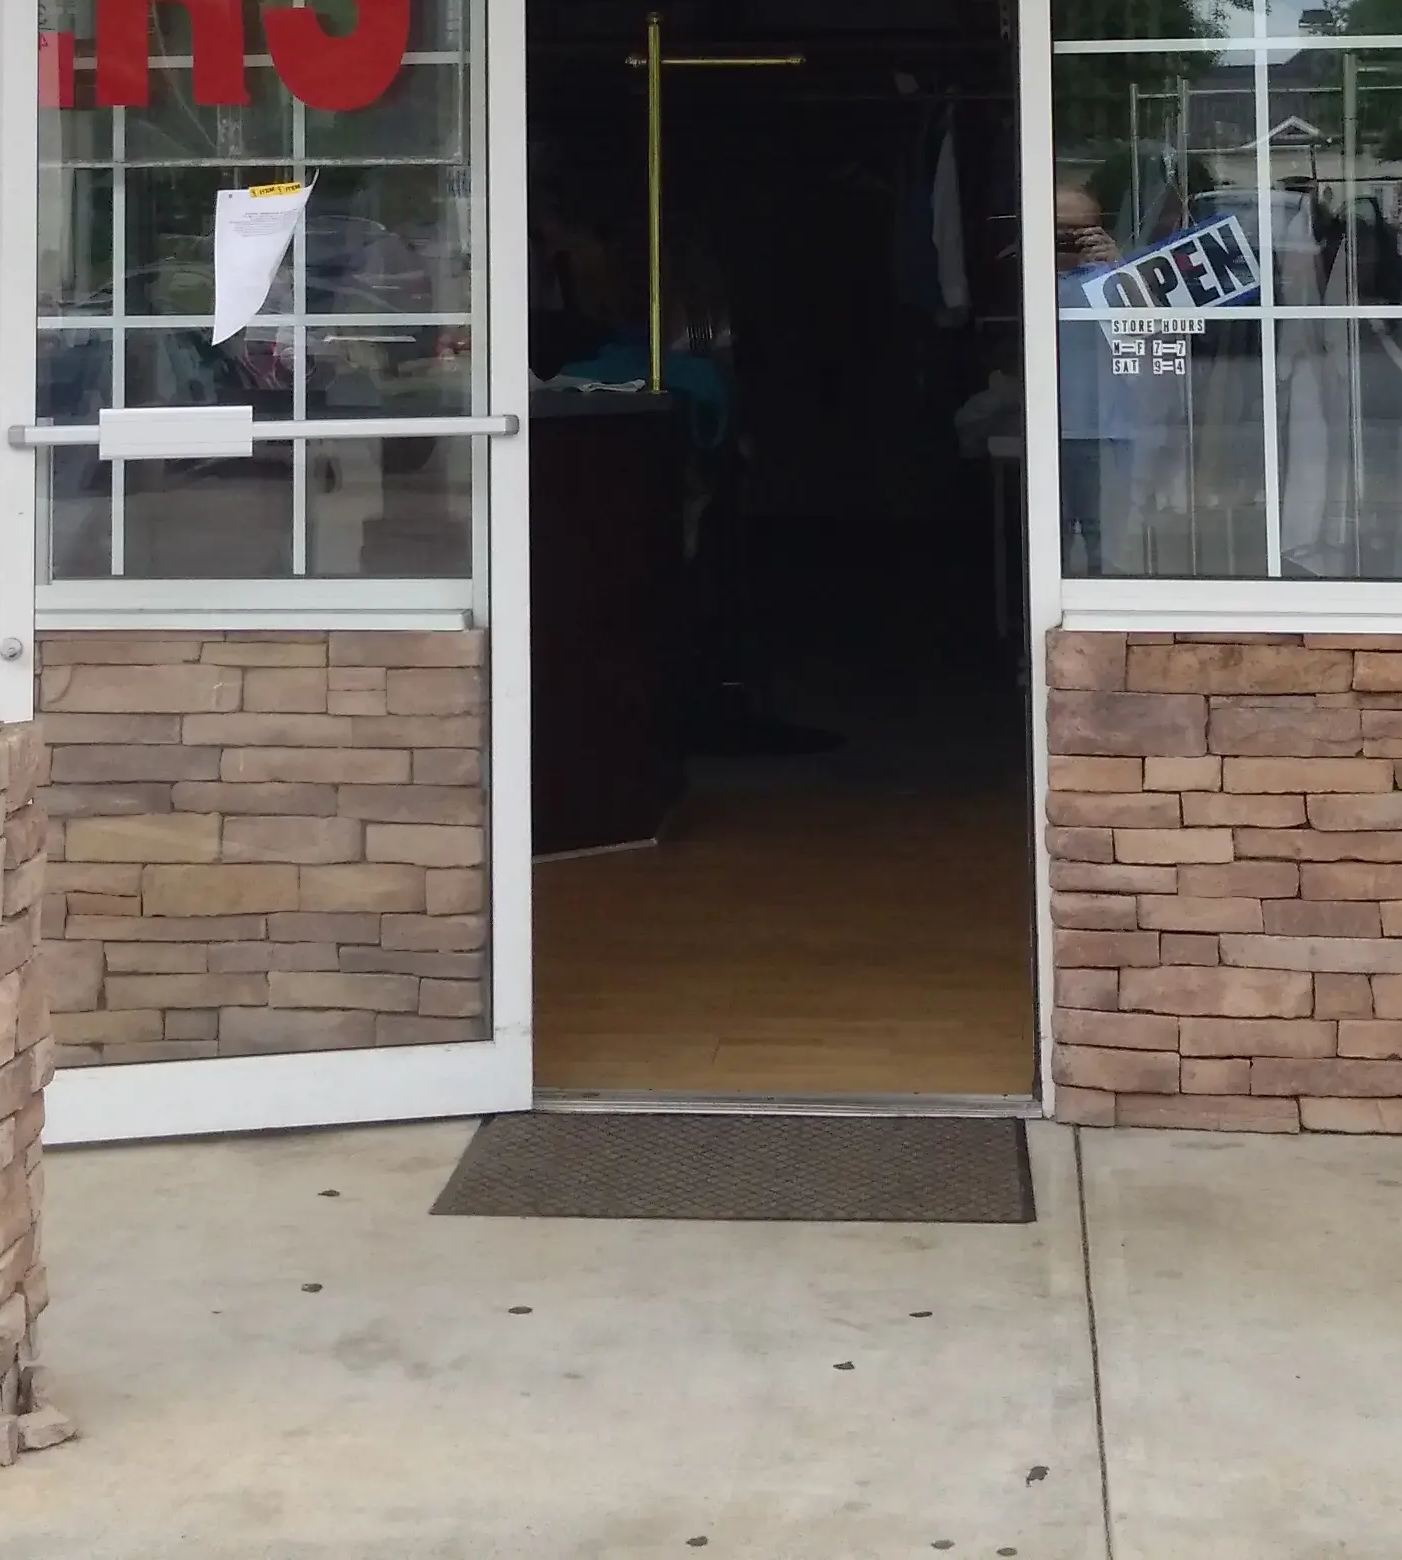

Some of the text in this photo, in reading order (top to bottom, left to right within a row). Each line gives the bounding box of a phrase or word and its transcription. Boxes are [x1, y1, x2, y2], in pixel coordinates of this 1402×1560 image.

[1103, 224, 1255, 318] OPEN
[1113, 319, 1203, 332] STORE HOURS
[1114, 359, 1138, 373] SAT
